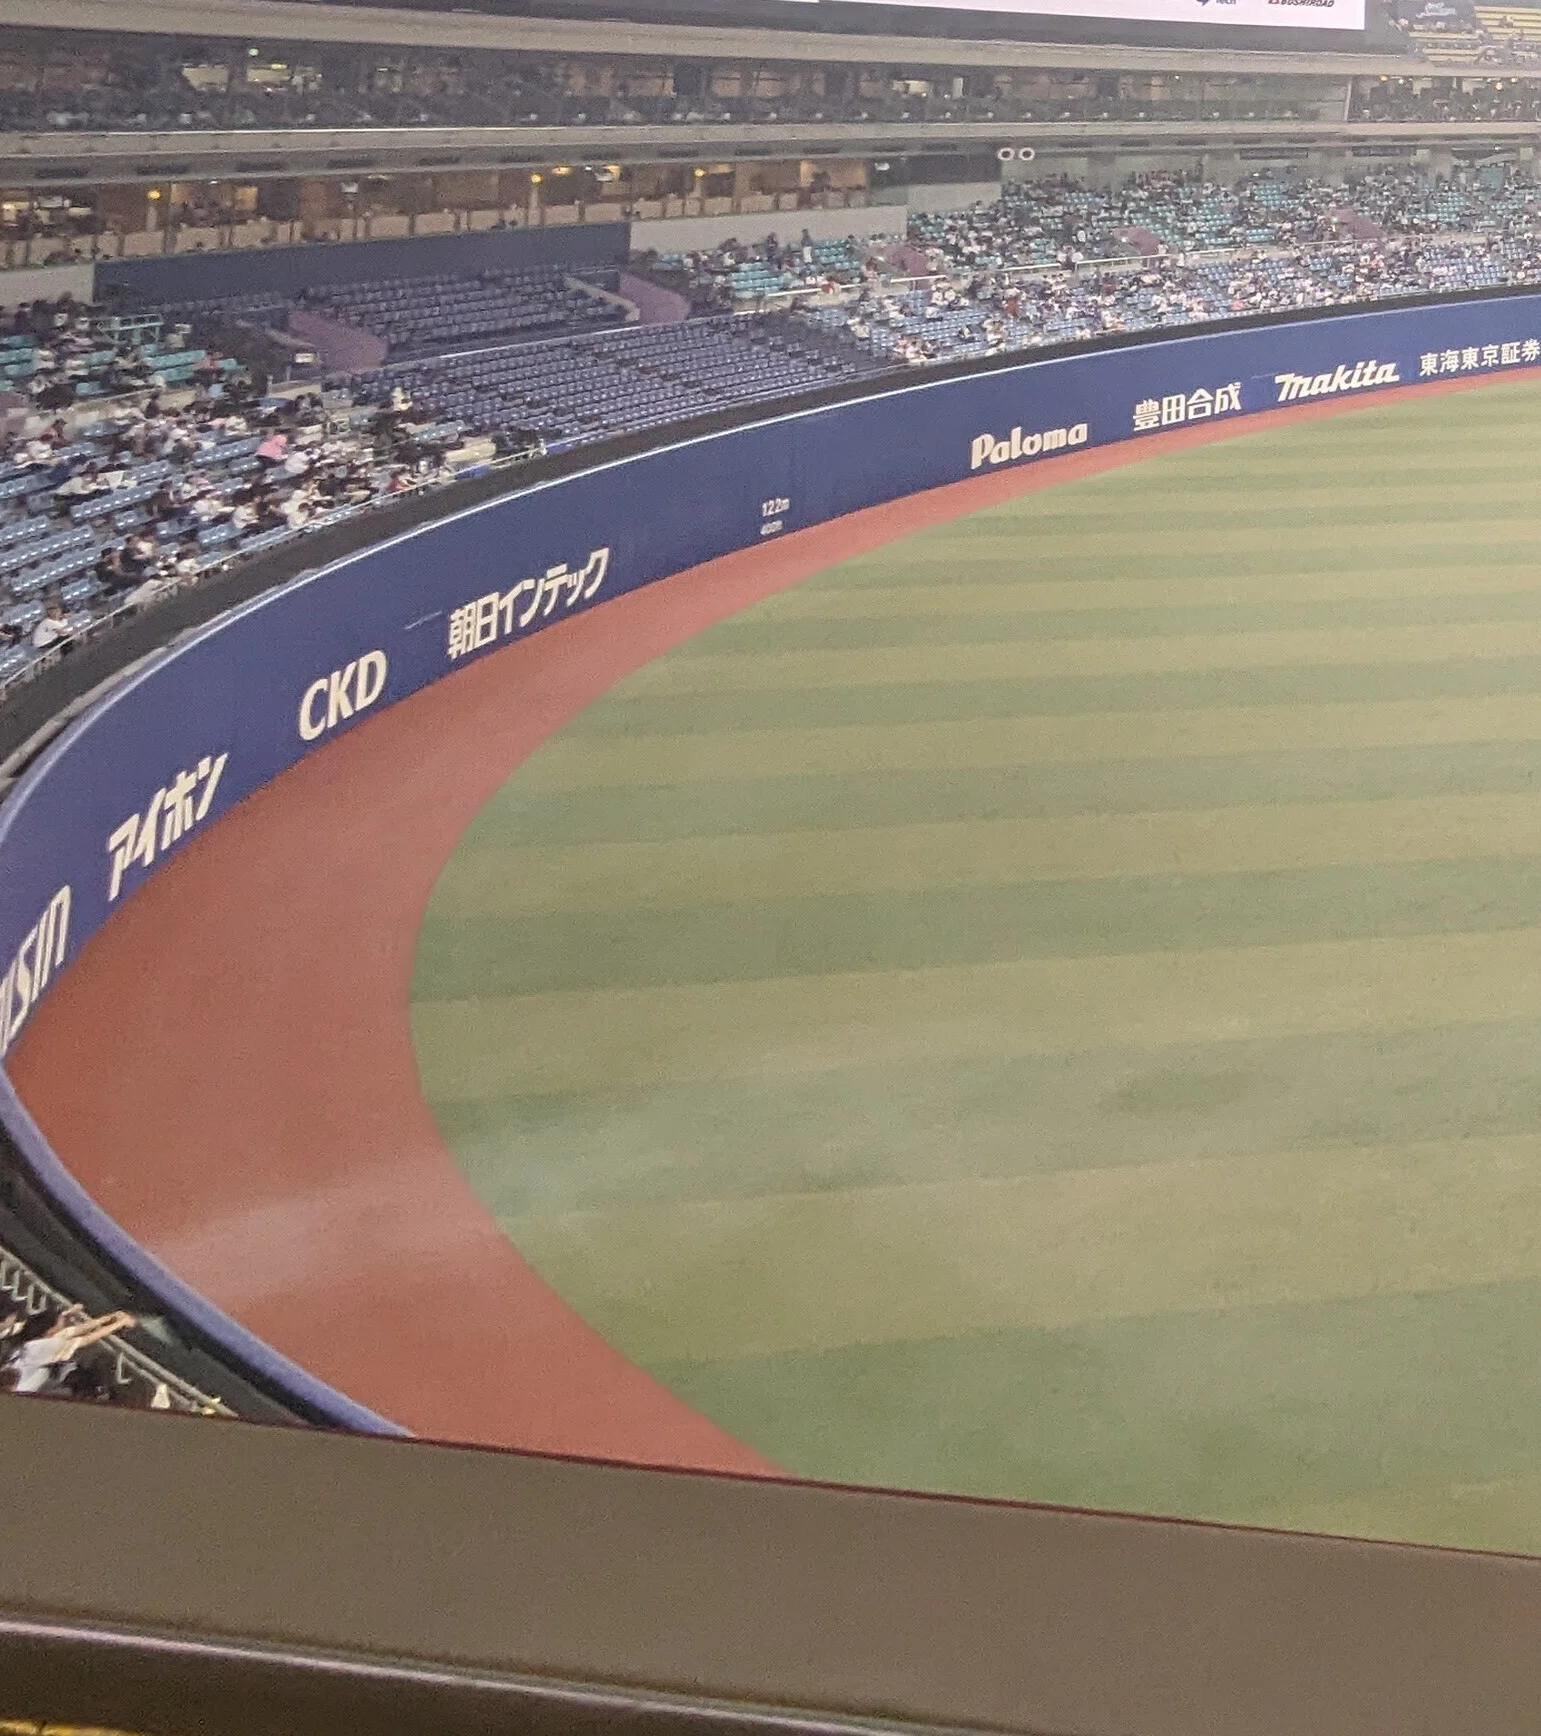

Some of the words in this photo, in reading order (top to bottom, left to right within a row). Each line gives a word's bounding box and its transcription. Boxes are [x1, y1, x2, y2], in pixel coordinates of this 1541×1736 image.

[1418, 338, 1541, 378] 東海東京証券
[1132, 381, 1243, 432] 豊田合成
[970, 422, 1088, 470] Paloma
[762, 497, 790, 517] 122m
[446, 547, 611, 660] 朝日インテック
[299, 648, 388, 742] CKD
[108, 752, 229, 902] アイホン
